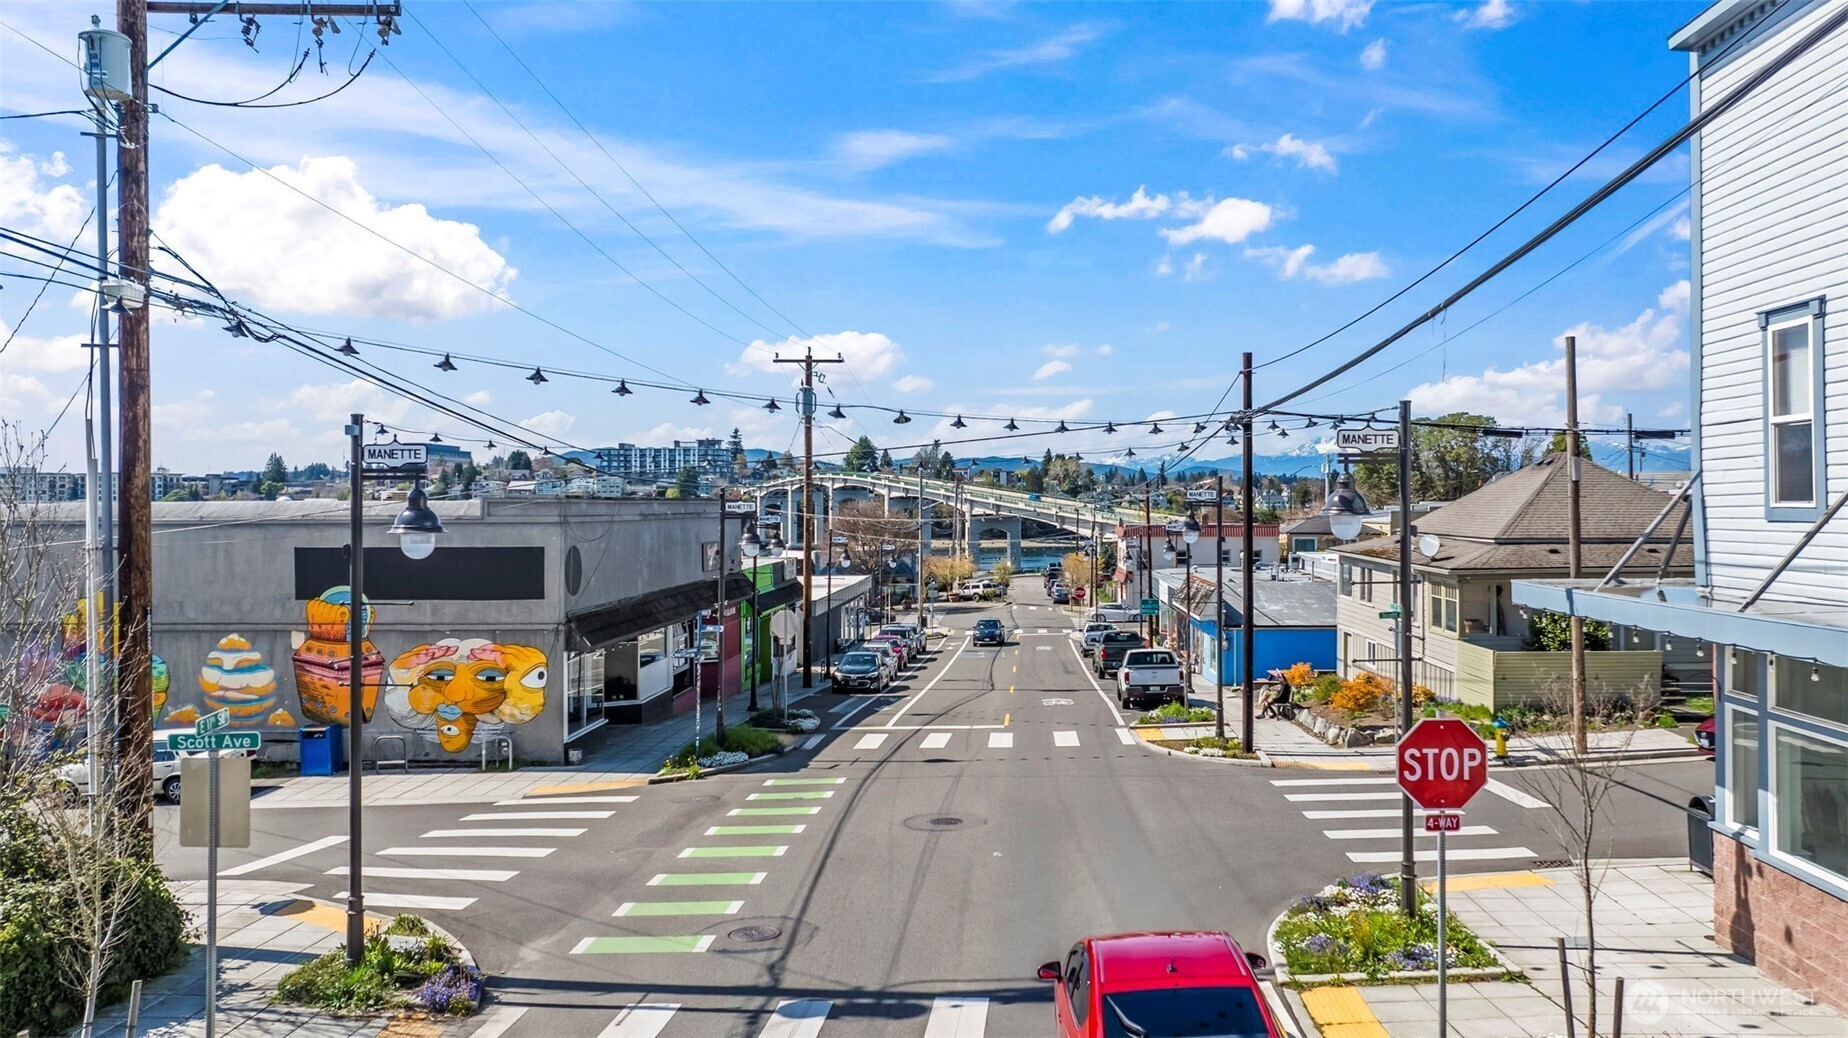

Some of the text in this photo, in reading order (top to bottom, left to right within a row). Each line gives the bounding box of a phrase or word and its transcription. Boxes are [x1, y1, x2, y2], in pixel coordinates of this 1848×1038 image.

[1342, 434, 1394, 444] MANETTE
[367, 448, 422, 459] MANETTE
[199, 720, 205, 734] E
[177, 735, 251, 749] Scott Ave
[1403, 747, 1482, 781] STOP
[1427, 817, 1458, 828] 4-WAY
